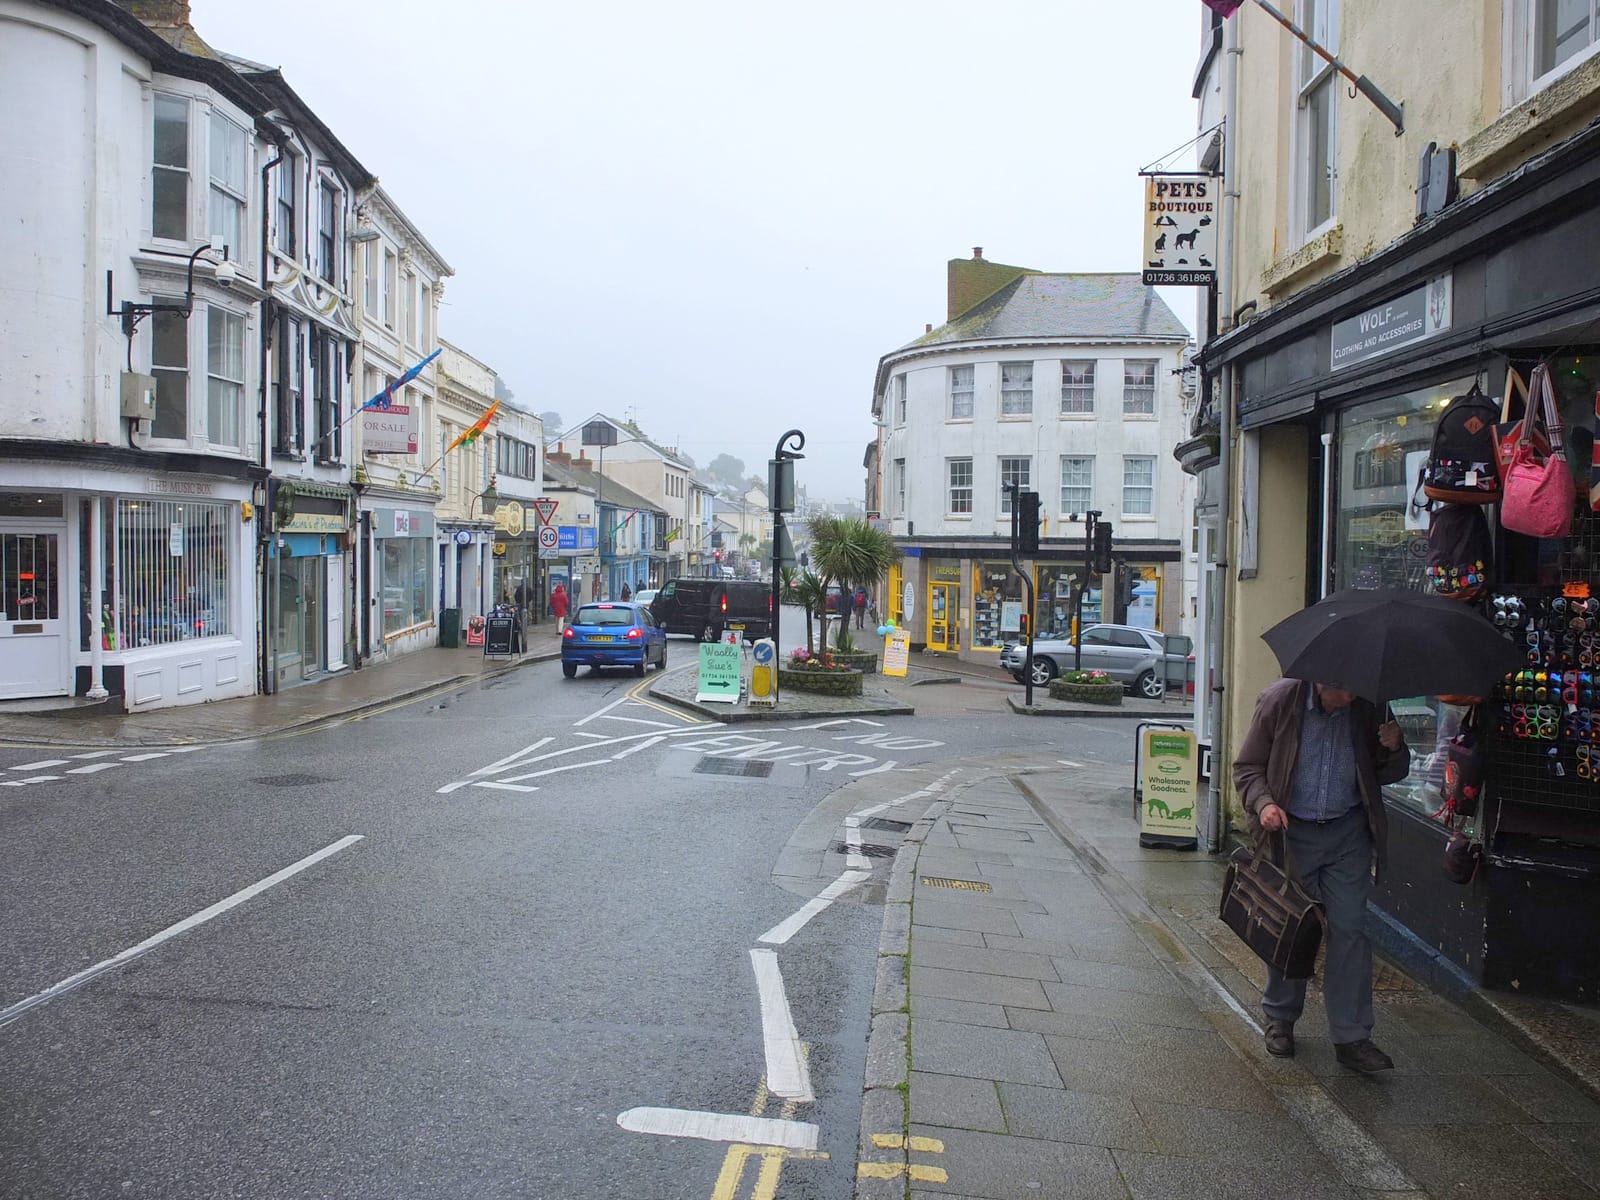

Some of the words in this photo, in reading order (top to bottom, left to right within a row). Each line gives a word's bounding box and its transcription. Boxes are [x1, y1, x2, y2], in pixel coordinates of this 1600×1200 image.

[1156, 182, 1207, 197] PETS
[1149, 202, 1213, 213] BOUTIQUE
[1146, 273, 1175, 281] 01736
[1359, 306, 1392, 333] WOLF
[1334, 341, 1363, 359] CLOTHING
[1364, 336, 1377, 349] AND
[1378, 319, 1423, 343] ACCESSORIES
[363, 421, 379, 431] OR
[380, 423, 408, 433] SALE
[169, 480, 195, 494] MUSIC
[196, 483, 213, 495] BOX
[543, 533, 555, 542] 30
[702, 645, 738, 659] Woolly
[707, 659, 733, 671] Sue's
[832, 733, 945, 750] NO
[669, 735, 898, 777] ENTRY
[1149, 776, 1191, 786] Wholesome
